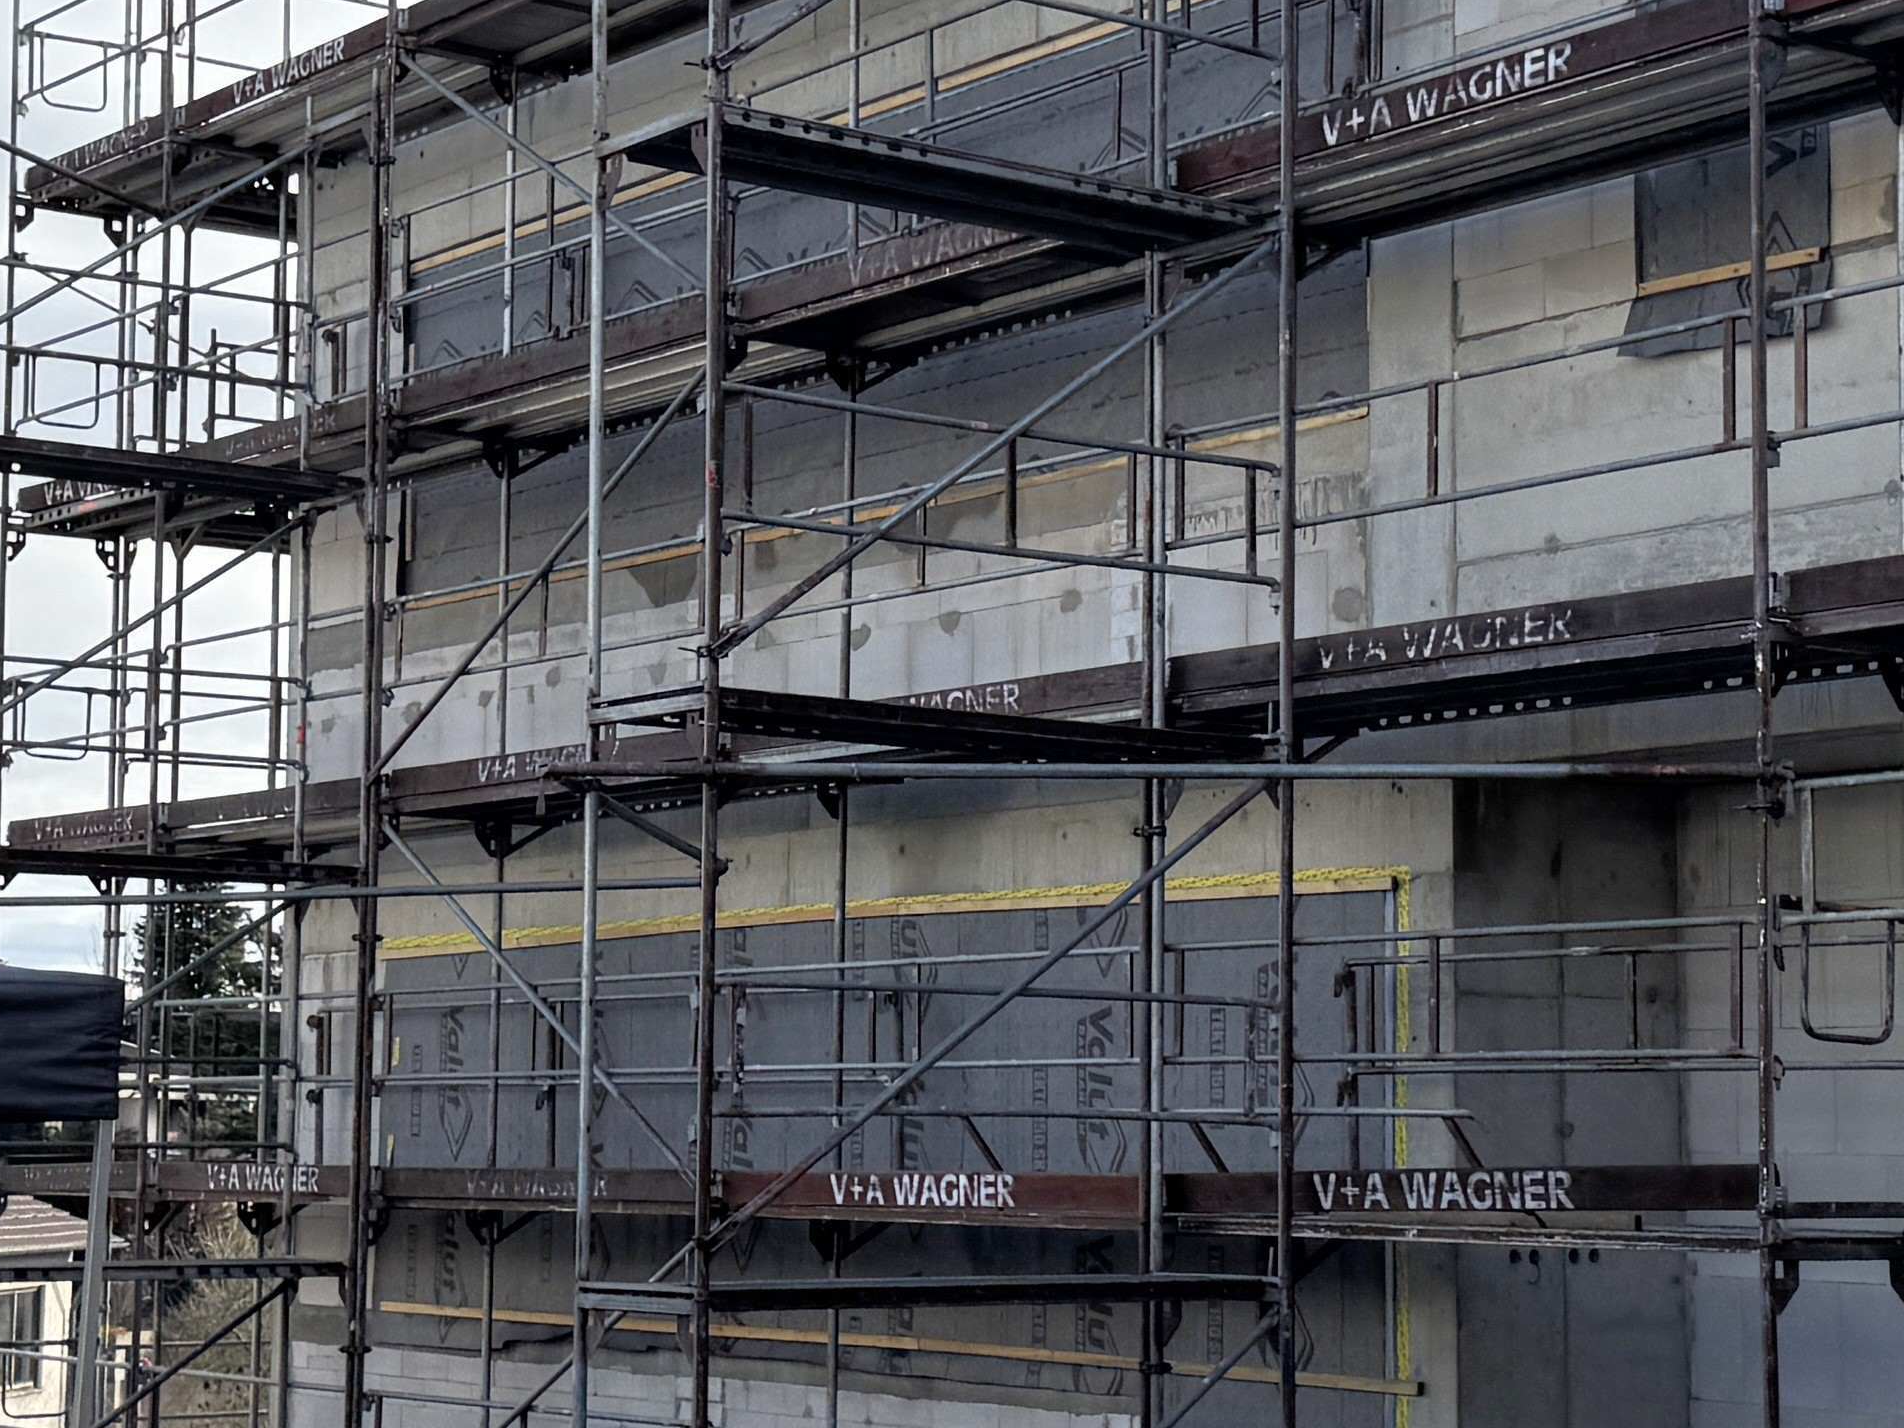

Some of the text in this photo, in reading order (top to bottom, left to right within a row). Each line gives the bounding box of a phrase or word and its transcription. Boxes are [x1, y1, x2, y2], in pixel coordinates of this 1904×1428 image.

[232, 36, 346, 105] V+A WAGNER
[1321, 42, 1573, 147] V+A WAGNER
[207, 1163, 240, 1191] V+A
[830, 1172, 1016, 1209] V+A WAGNER
[1313, 1170, 1577, 1212] V+A WAGNER
